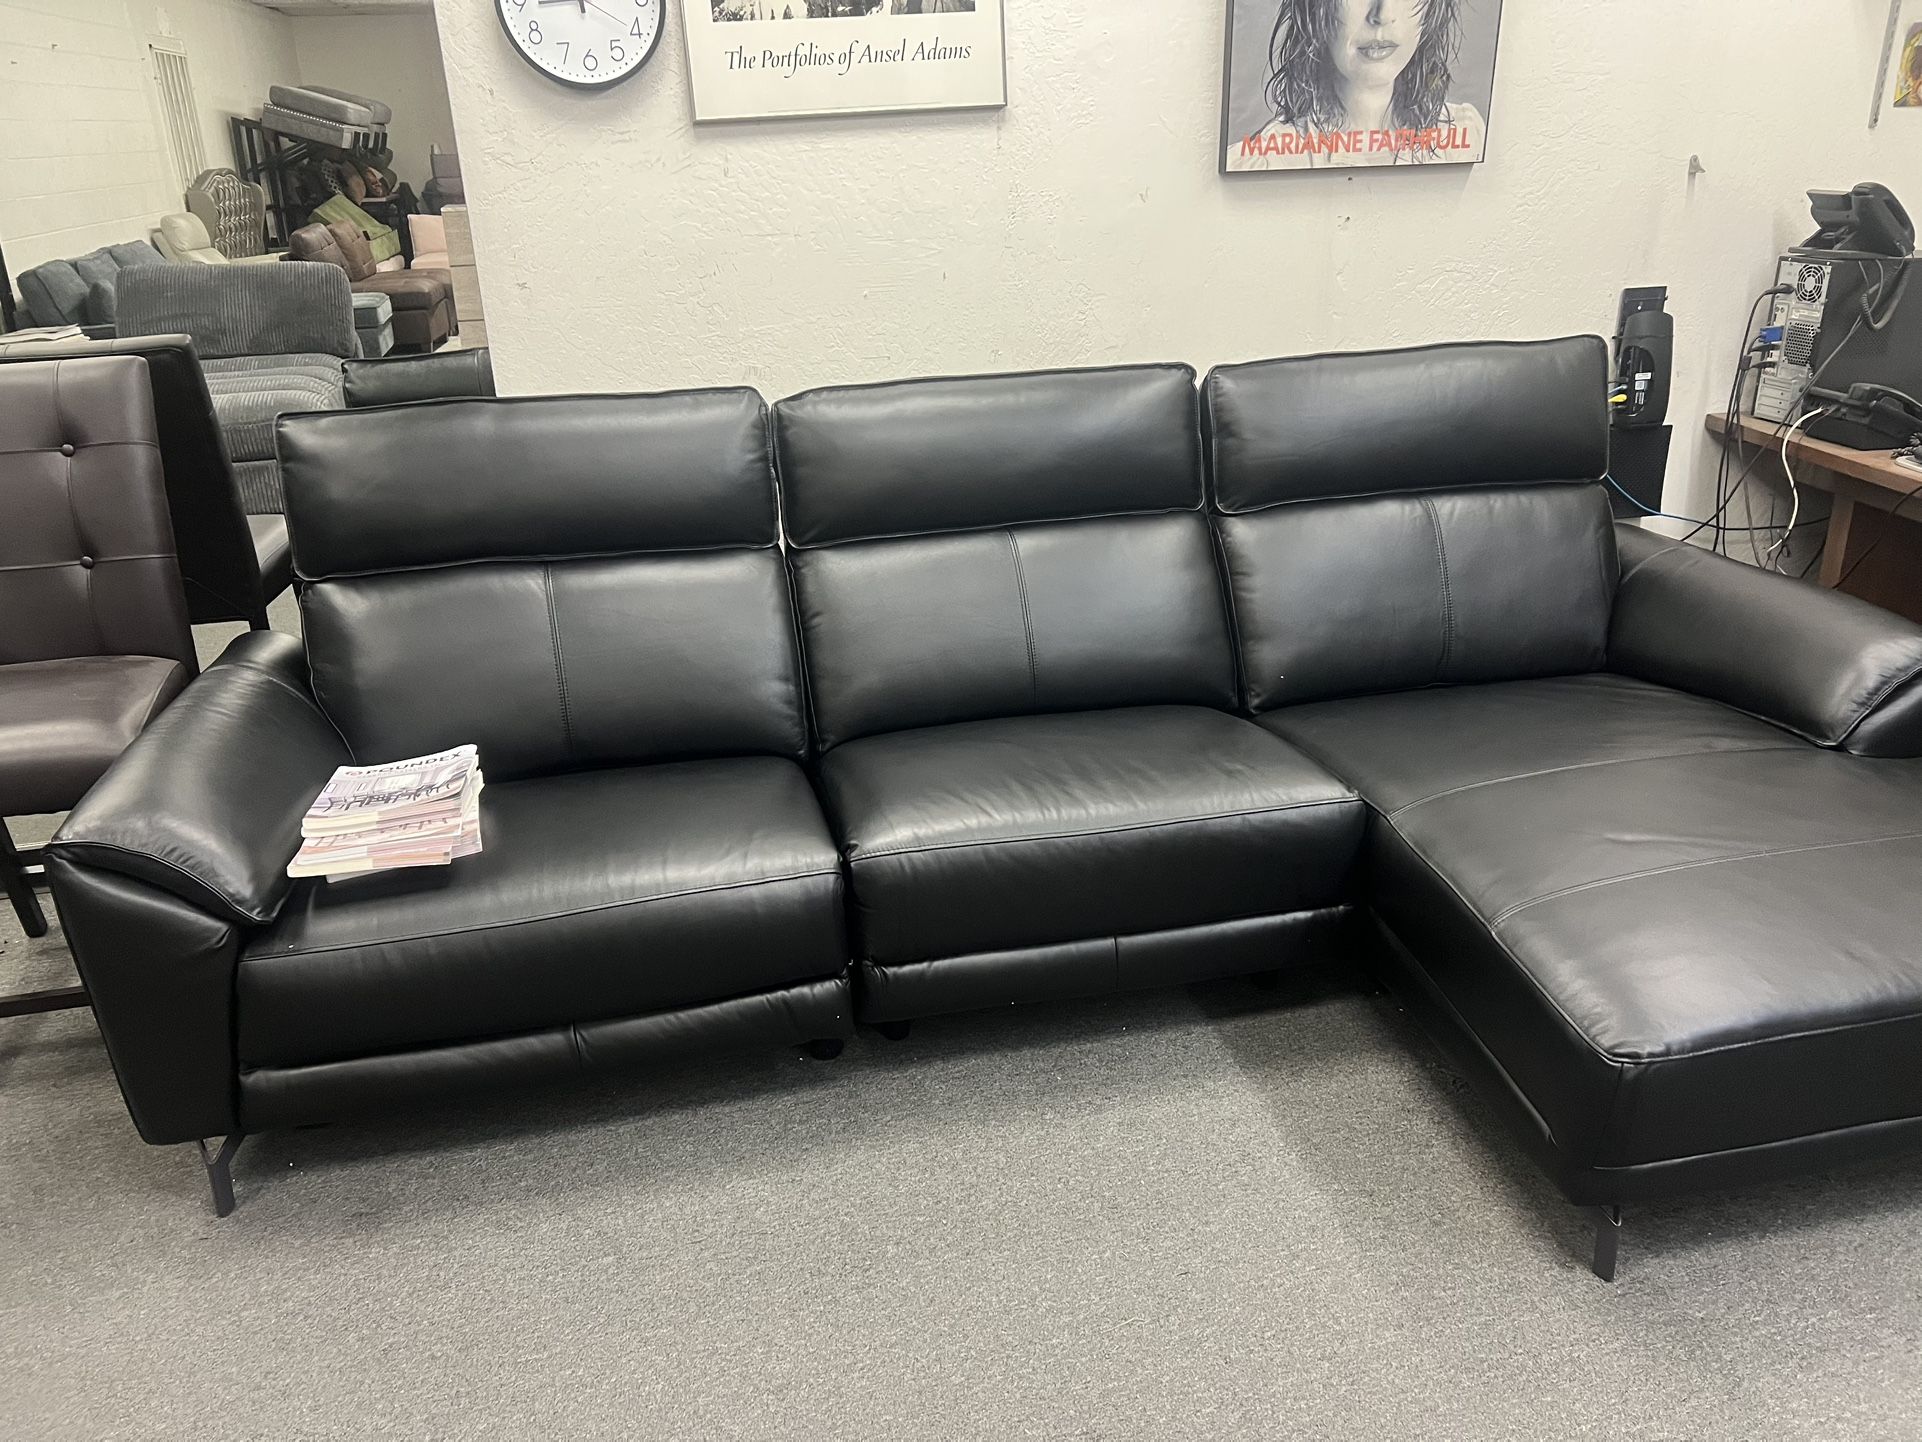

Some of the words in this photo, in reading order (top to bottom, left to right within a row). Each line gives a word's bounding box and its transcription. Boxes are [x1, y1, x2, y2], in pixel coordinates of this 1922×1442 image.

[528, 20, 543, 45] 8
[629, 16, 643, 39] 4
[556, 41, 570, 65] 7
[582, 48, 598, 72] 6
[609, 39, 625, 62] 5
[724, 45, 757, 71] The
[761, 42, 835, 78] Portfolios
[838, 40, 859, 76] of
[858, 38, 906, 65] Ansel
[911, 36, 972, 62] Adams
[1240, 130, 1364, 157] MARIANNE
[1368, 127, 1471, 153] FAITHFULL
